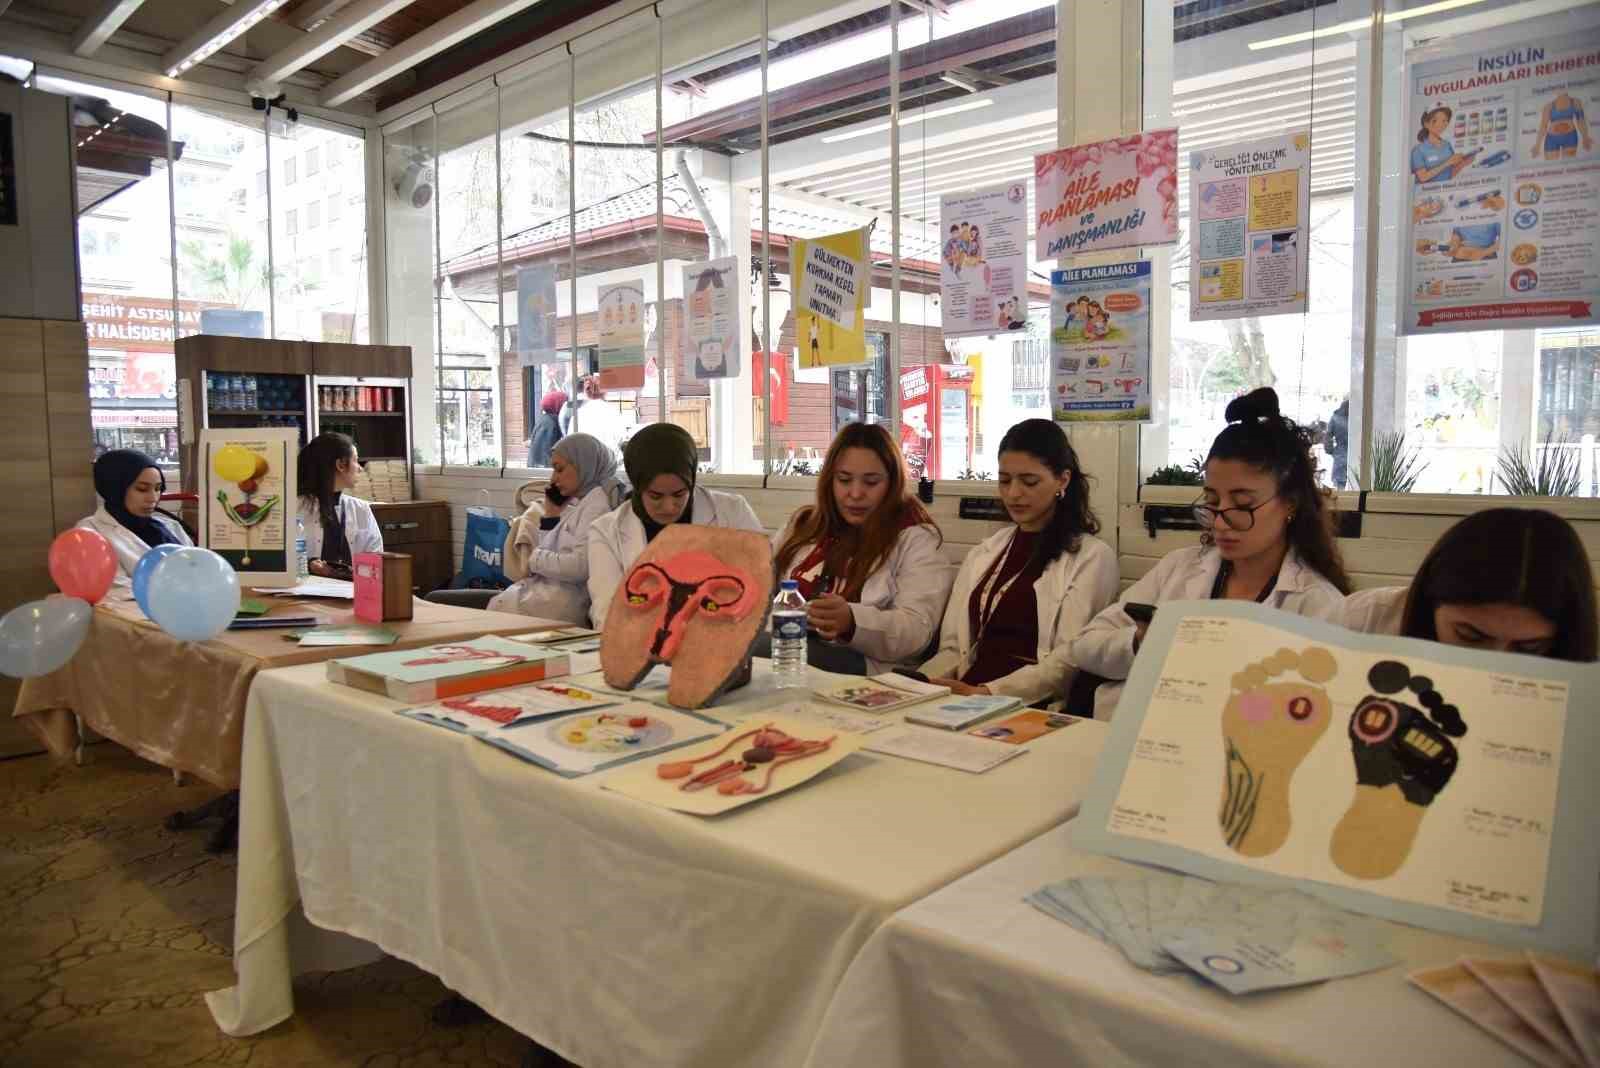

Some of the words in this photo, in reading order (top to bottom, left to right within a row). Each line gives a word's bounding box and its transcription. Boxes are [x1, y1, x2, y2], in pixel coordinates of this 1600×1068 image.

[1477, 47, 1545, 73] İNSÜLİN
[1423, 67, 1532, 97] UYGULAMALARI
[1063, 171, 1100, 200] AİLE
[1037, 176, 1141, 229] PLANLAMASI
[1047, 208, 1146, 257] DANIŞMANLIĞI
[1080, 212, 1096, 226] ve
[834, 275, 855, 296] KEGEL
[1081, 264, 1137, 281] PLANLAMASI
